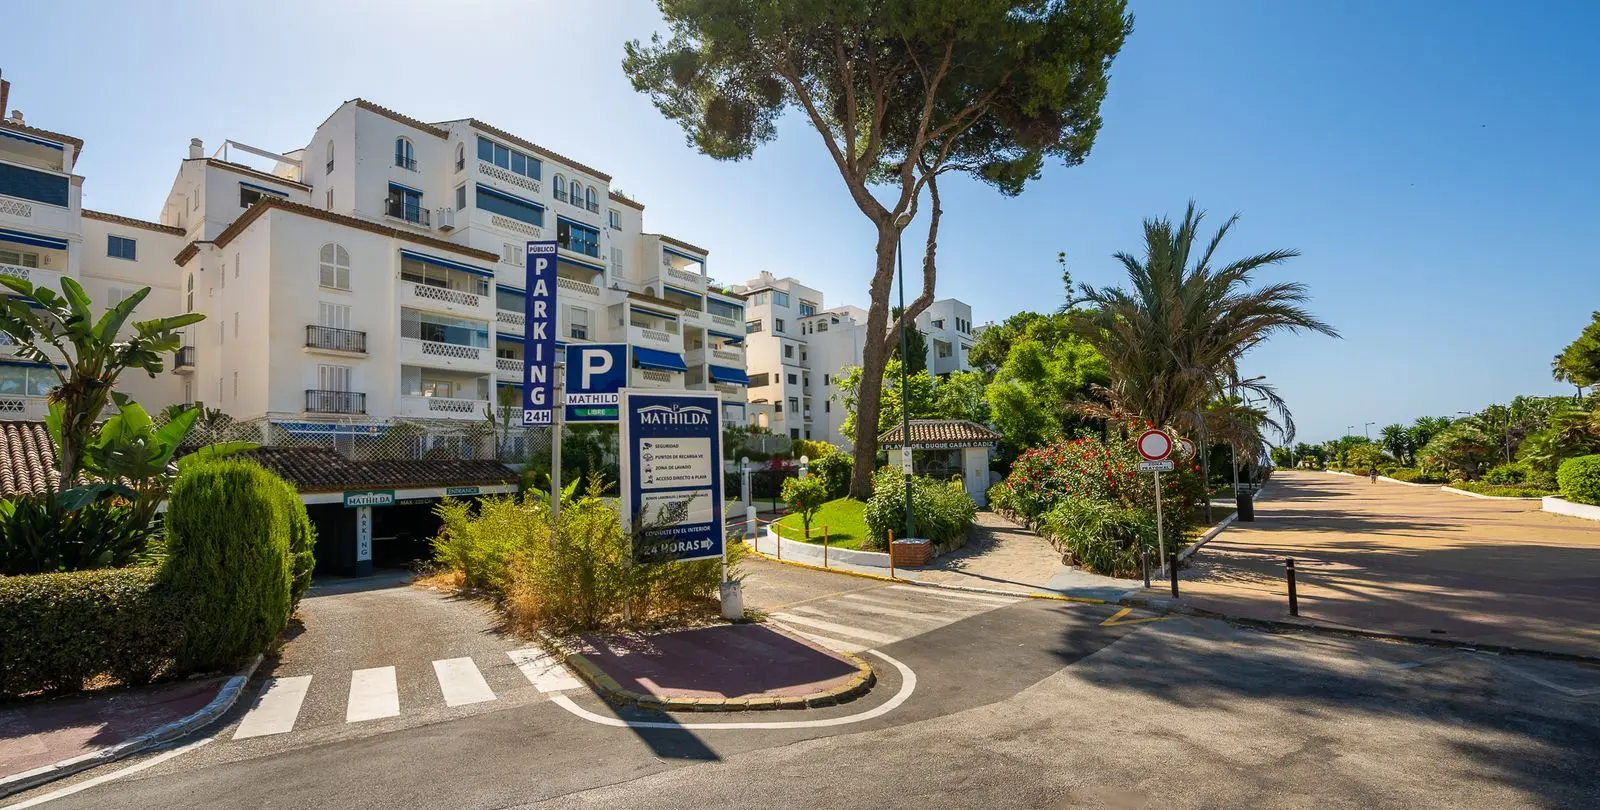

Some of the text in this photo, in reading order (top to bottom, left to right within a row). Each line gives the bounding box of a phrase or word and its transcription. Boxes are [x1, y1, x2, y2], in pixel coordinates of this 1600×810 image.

[529, 245, 554, 253] PÚBLICO
[530, 258, 549, 405] PARKING
[581, 349, 613, 390] P
[568, 394, 619, 404] MATHILD
[672, 404, 680, 412] P
[525, 411, 550, 422] 24H
[640, 412, 709, 425] MATHILDA
[448, 487, 478, 495] ENTRANCE
[349, 496, 391, 505] MATHILDA
[687, 525, 711, 533] INTERIOR
[661, 540, 699, 553] HORAS
